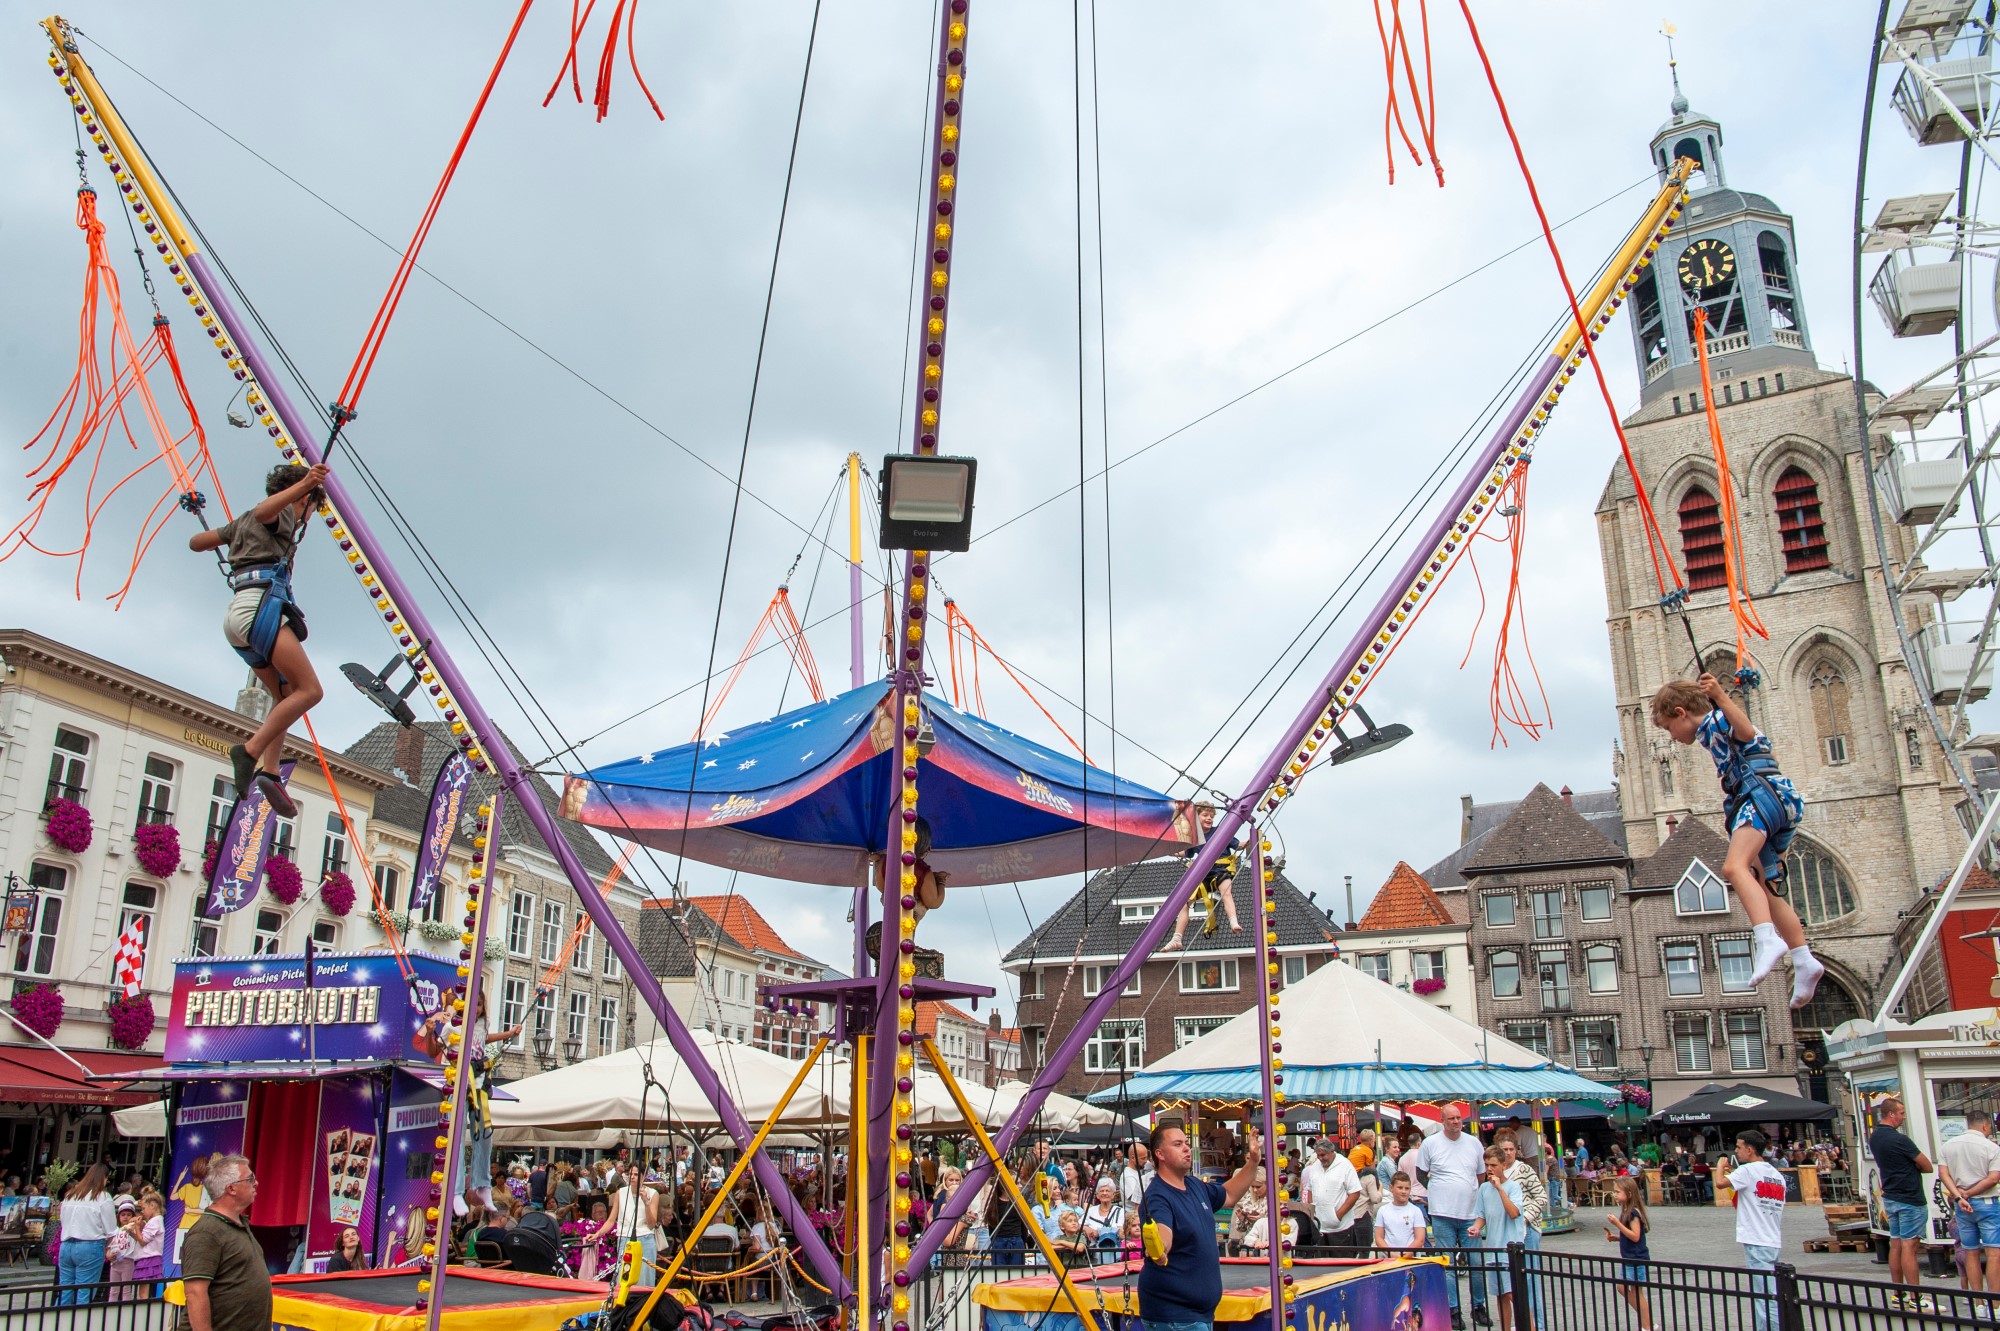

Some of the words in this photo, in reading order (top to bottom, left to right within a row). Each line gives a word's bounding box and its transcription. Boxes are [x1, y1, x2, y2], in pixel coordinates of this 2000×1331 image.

[184, 728, 196, 742] de
[197, 733, 231, 755] Bourg
[231, 805, 255, 866] Charlie's
[434, 788, 463, 876] tobooth
[281, 969, 306, 982] Pictu
[316, 962, 349, 977] Perfect
[184, 986, 381, 1027] PHOTOBOOTH
[182, 1103, 243, 1122] PHOTOBOOTH
[1297, 1121, 1321, 1131] CORNET
